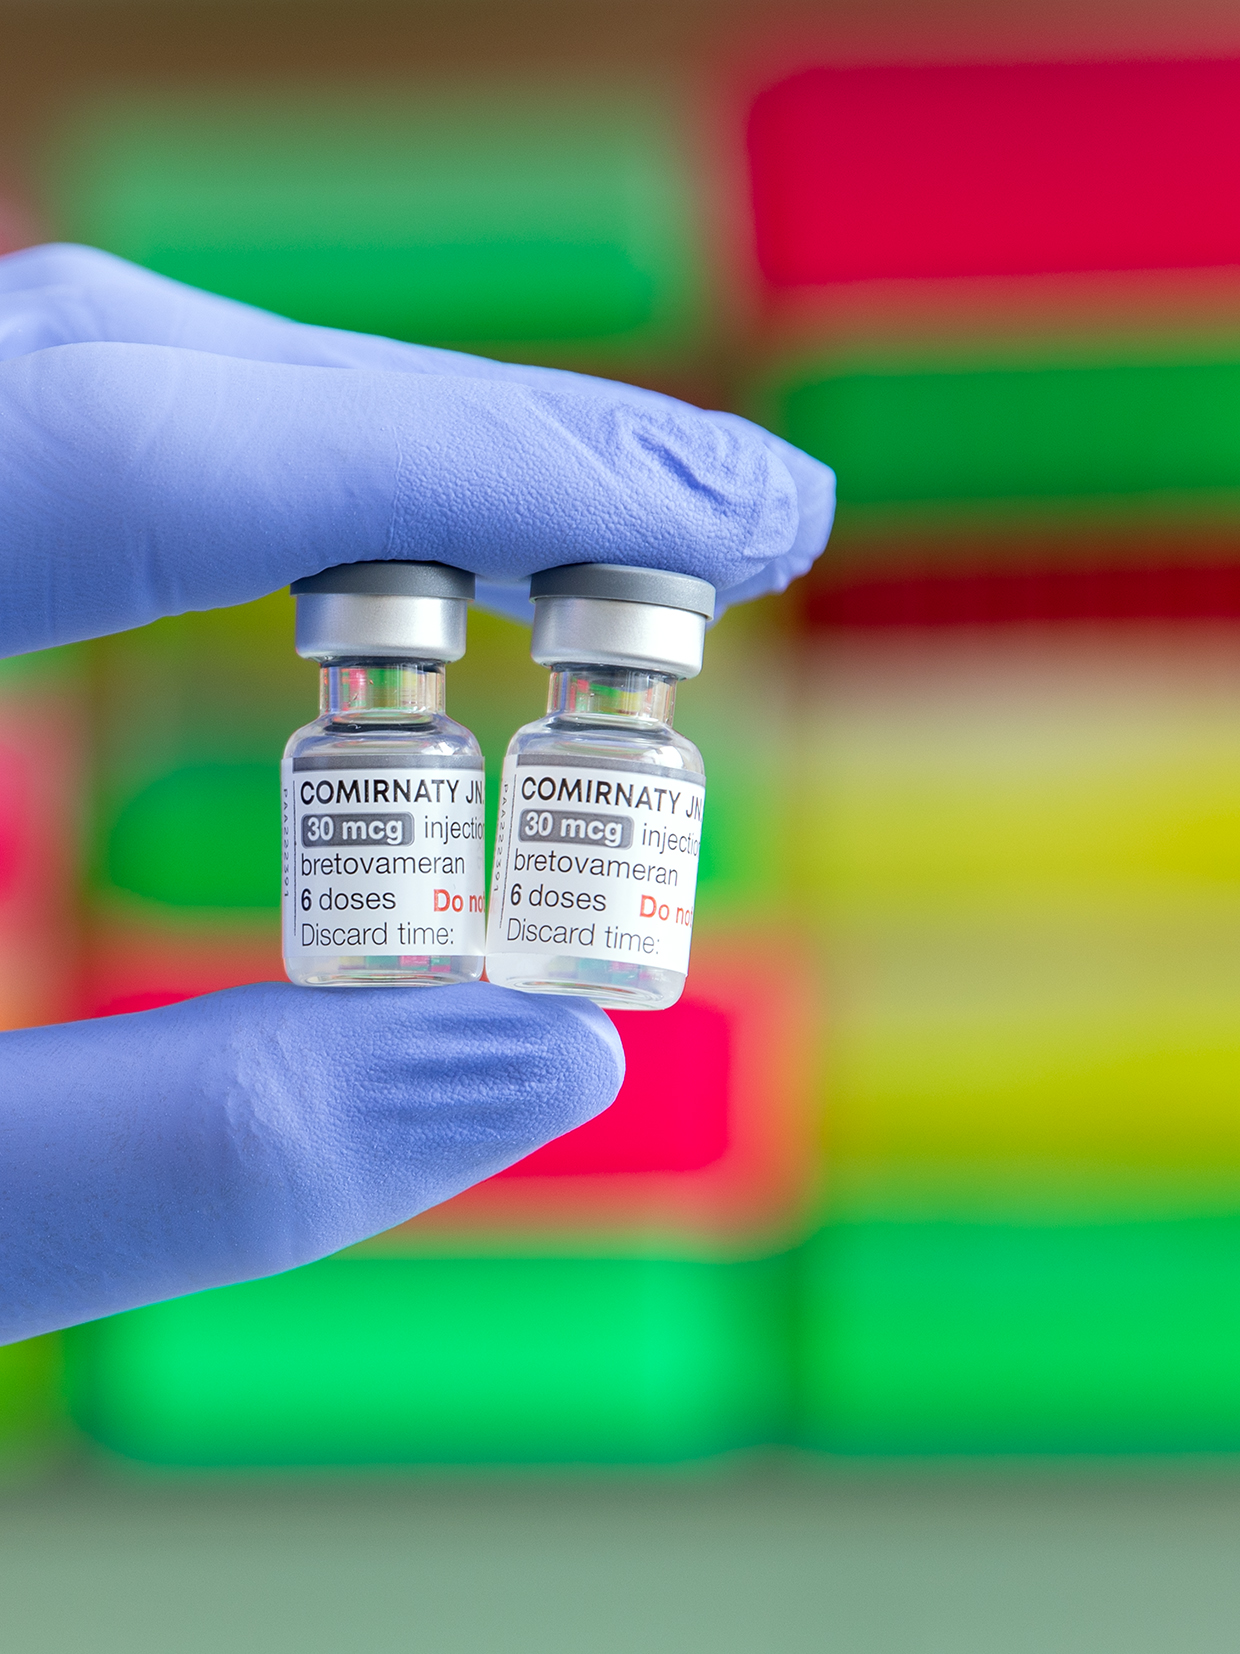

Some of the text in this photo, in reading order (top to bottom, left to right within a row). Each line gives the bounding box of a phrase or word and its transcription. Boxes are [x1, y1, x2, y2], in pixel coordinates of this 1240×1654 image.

[300, 779, 459, 805] COMIRNATY
[521, 776, 681, 814] COMIRNATY
[307, 815, 484, 845] 30 mcg injectio
[525, 811, 700, 856] 30 mcg injectio
[301, 853, 465, 876] bretovameran
[514, 848, 678, 886] bretovameran
[301, 888, 312, 911] 6
[319, 888, 396, 911] doses
[433, 888, 463, 913] Do
[511, 883, 522, 906] 6
[529, 884, 606, 911] doses
[640, 894, 670, 921] Do
[301, 922, 454, 946] Discard time:
[507, 917, 660, 955] Discard time:
